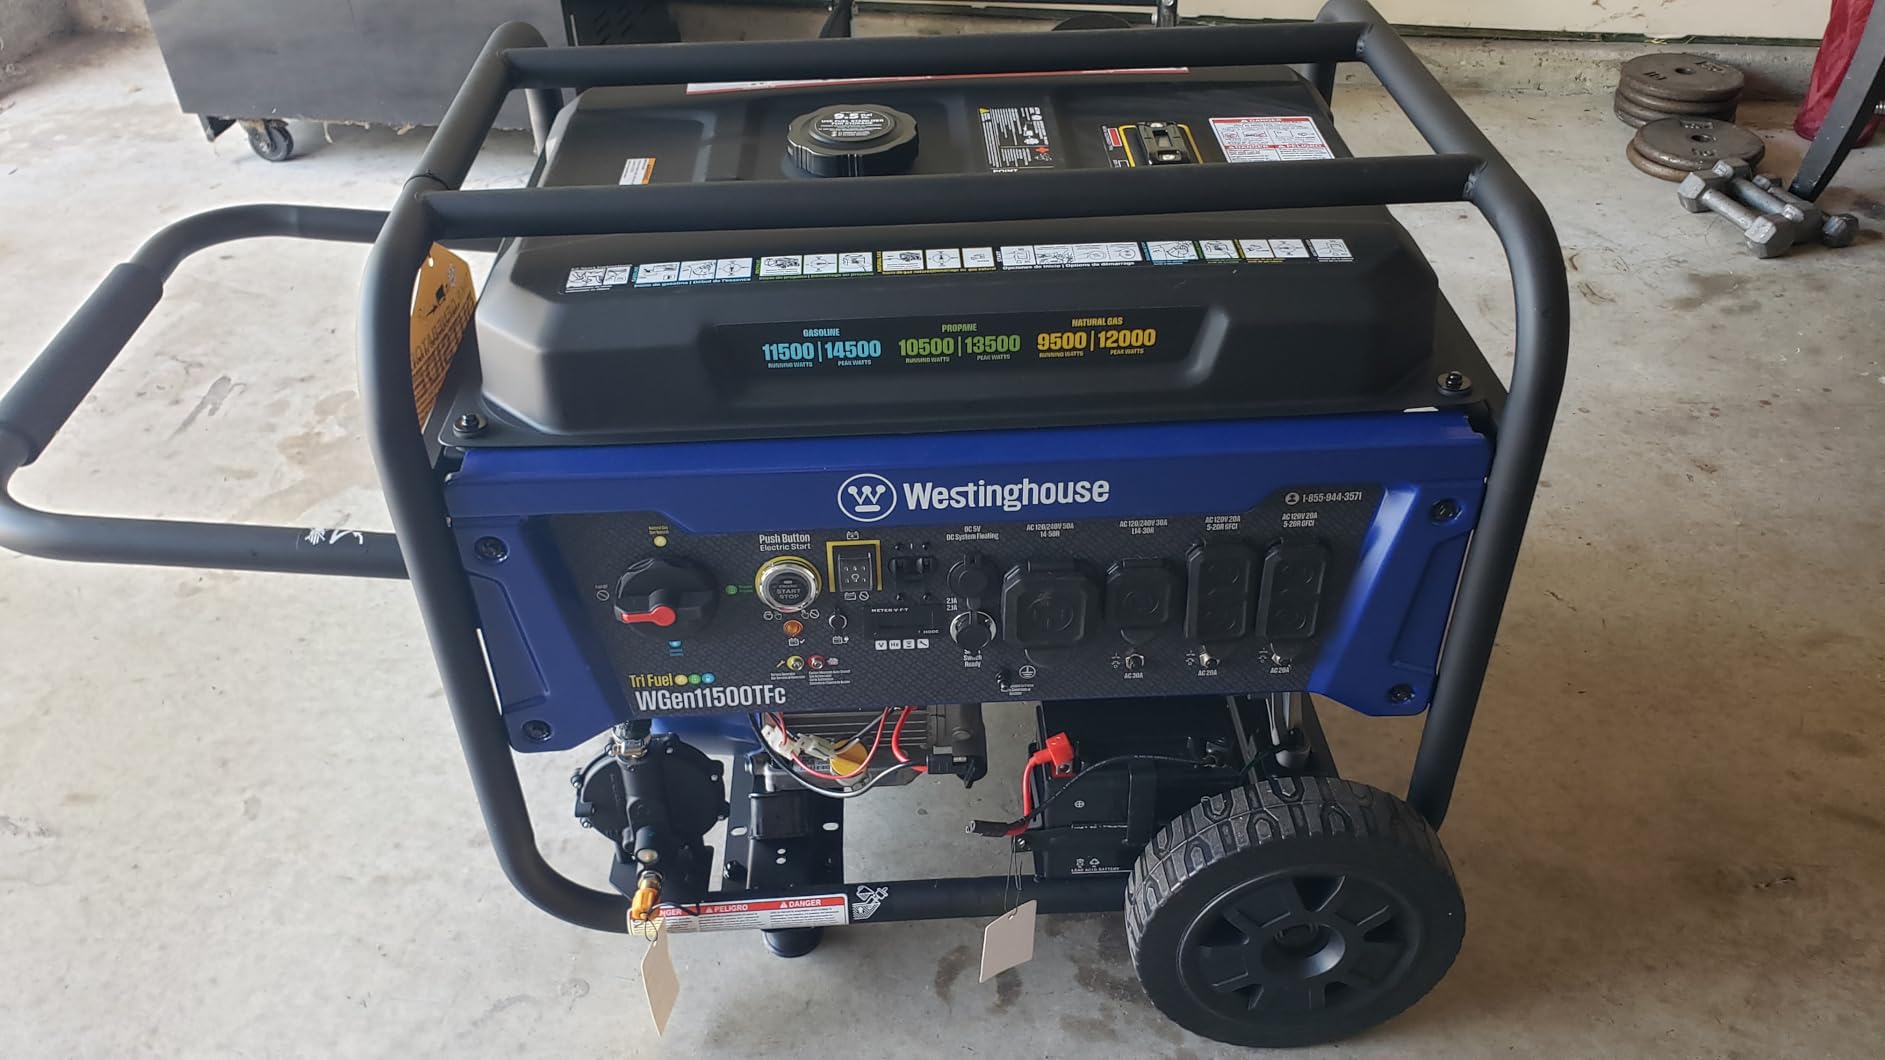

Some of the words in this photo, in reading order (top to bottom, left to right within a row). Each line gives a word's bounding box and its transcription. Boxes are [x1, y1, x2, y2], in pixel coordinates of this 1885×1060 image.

[942, 323, 977, 332] PROPANE
[1072, 318, 1106, 327] NATURAL
[1107, 317, 1123, 325] GAS
[803, 328, 840, 337] GASOLINE
[1037, 332, 1087, 350] 9500
[1098, 329, 1156, 348] 12000
[762, 342, 815, 361] 11500
[825, 340, 882, 359] 14500
[899, 337, 954, 356] 10500
[965, 335, 1020, 353] 13500
[903, 478, 1110, 511] Westinghouse
[1302, 492, 1362, 503] 1-855-944-3571
[759, 533, 780, 544] Push
[781, 532, 810, 543] Button
[955, 533, 976, 541] System
[977, 532, 999, 540] Floating
[629, 675, 645, 688] Tri
[647, 673, 673, 686] Fuel
[635, 685, 786, 711] WGen11500TFc
[714, 904, 748, 912] PELIGRO
[789, 899, 822, 908] DANGER
[659, 908, 682, 917] NGER
